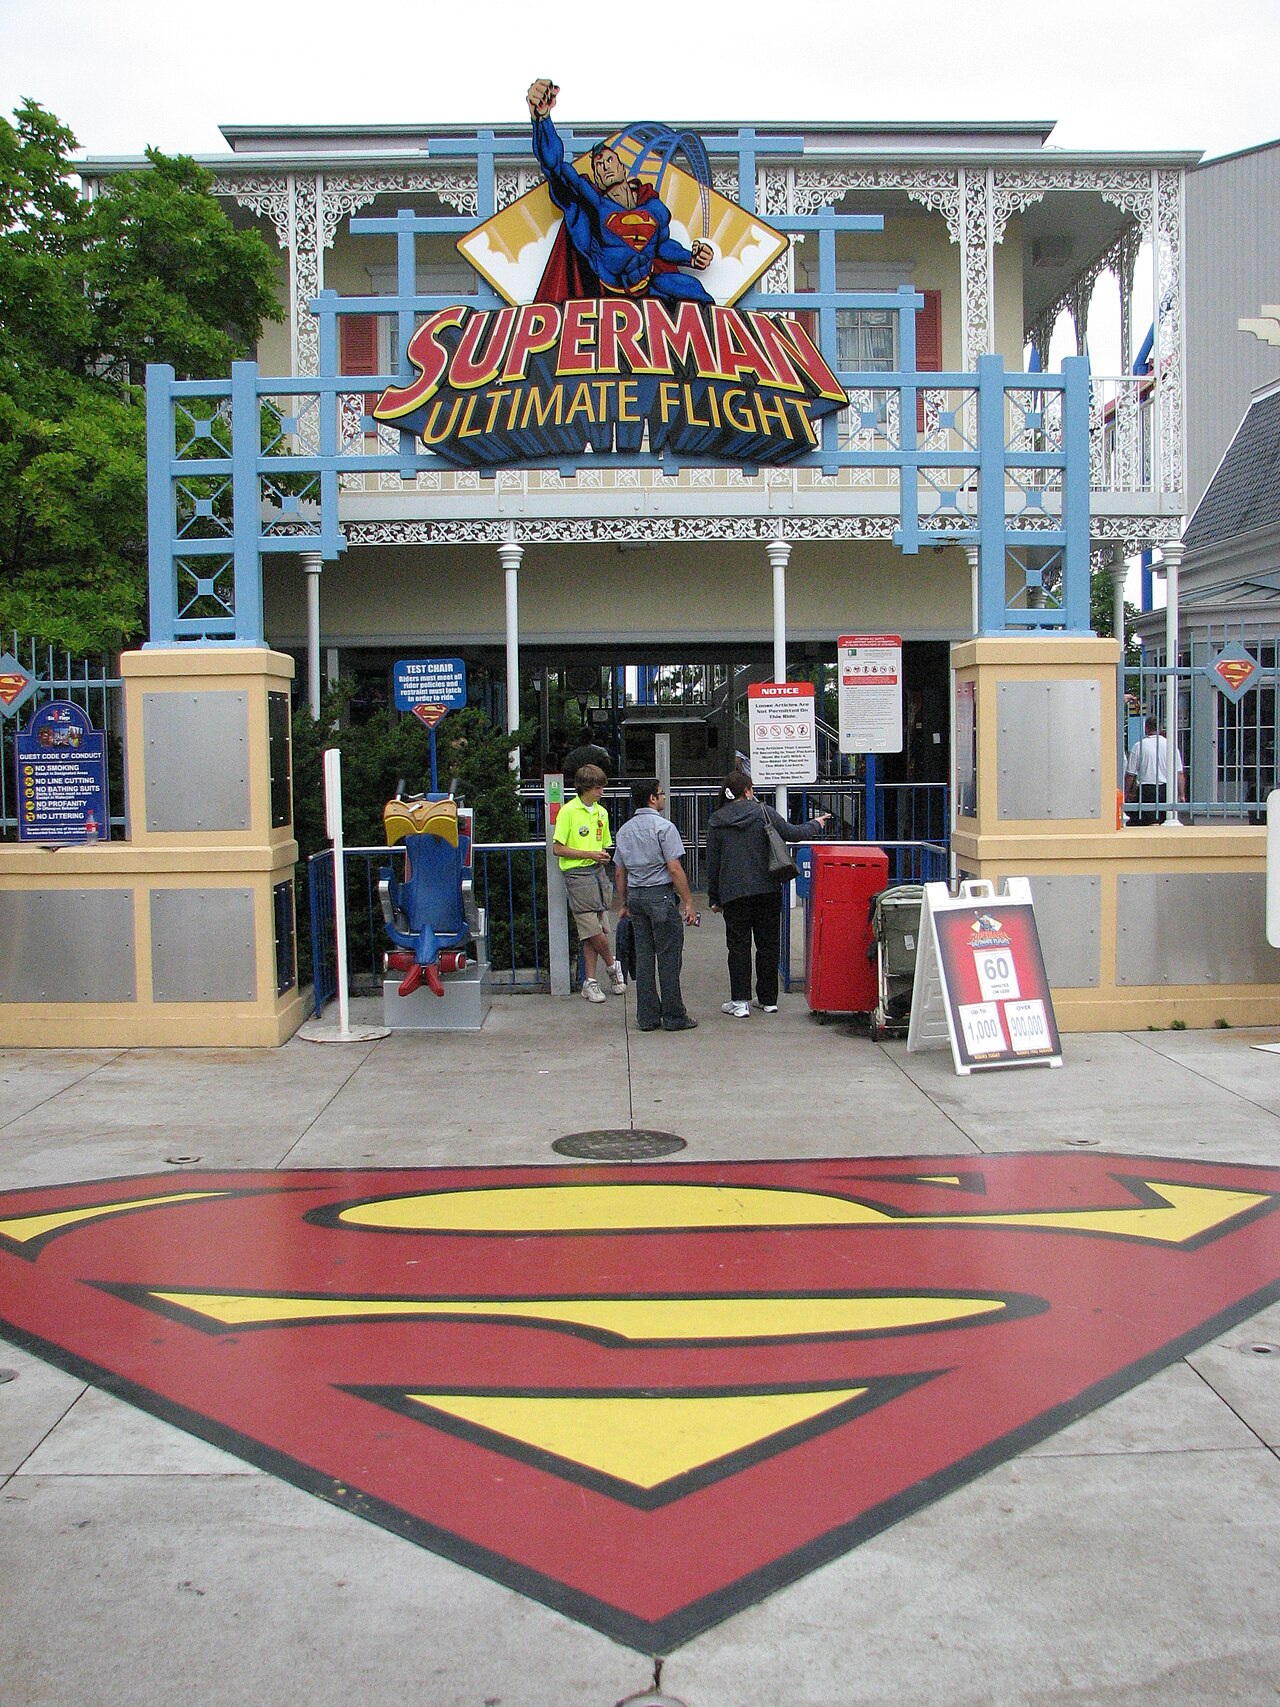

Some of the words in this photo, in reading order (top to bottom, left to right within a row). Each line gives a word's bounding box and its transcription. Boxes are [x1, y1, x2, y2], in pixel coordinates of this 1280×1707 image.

[372, 298, 849, 420] SUPERMAN
[422, 380, 641, 445] ULTIMATE
[661, 382, 818, 446] FLIGHT
[406, 665, 426, 674] TEST
[428, 663, 454, 673] CHAIR
[420, 681, 446, 689] policies
[761, 687, 799, 695] NOTICE
[983, 957, 1009, 981] 60
[967, 1018, 998, 1044] 1,000
[1010, 1014, 1044, 1040] 900,000
